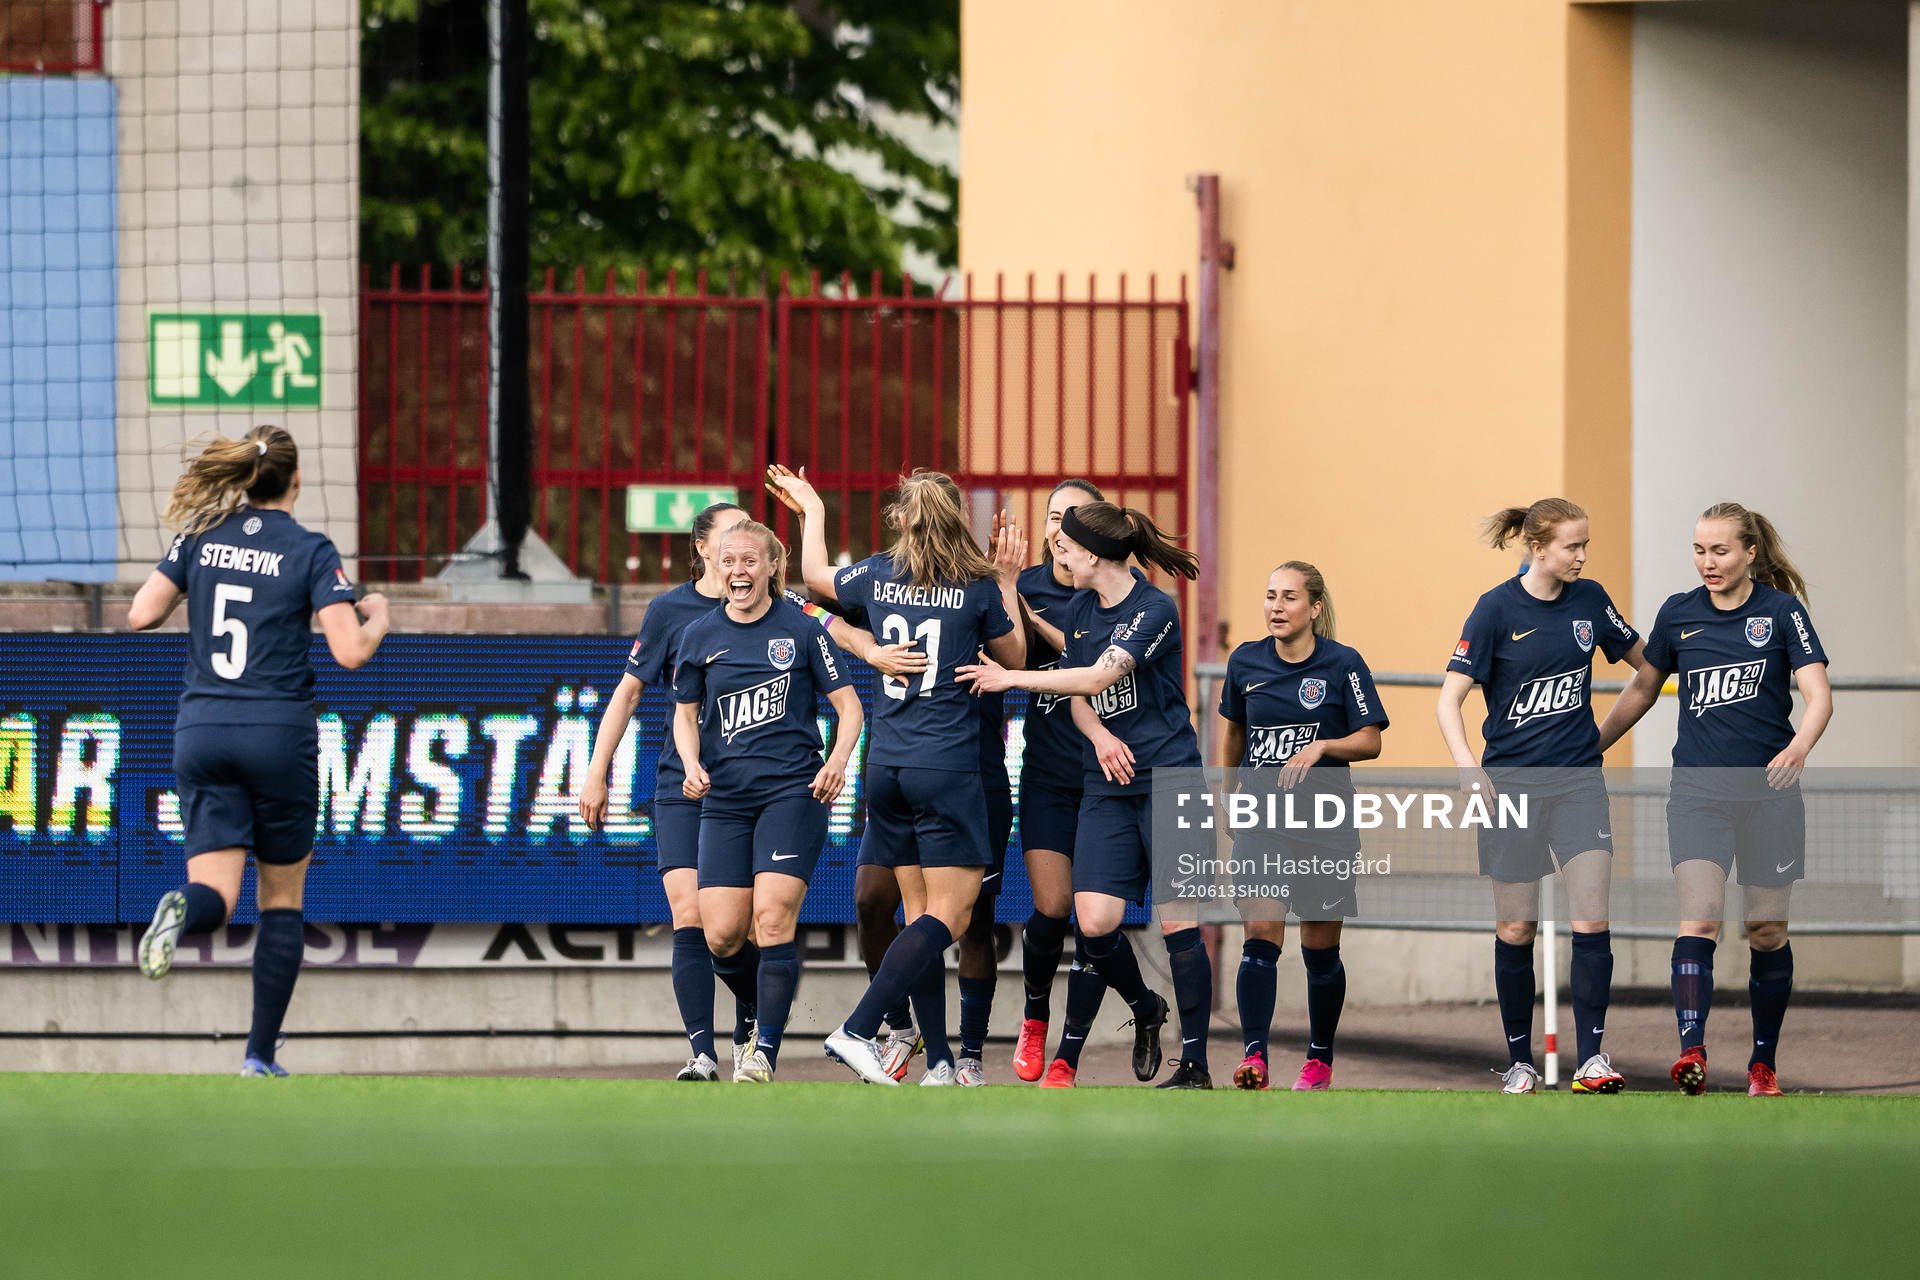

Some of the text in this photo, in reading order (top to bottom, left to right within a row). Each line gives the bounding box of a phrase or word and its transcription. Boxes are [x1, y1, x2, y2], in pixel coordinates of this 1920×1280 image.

[199, 542, 285, 577] STENEVIK
[873, 580, 965, 609] BÆKKELUND
[211, 583, 253, 680] 5
[1144, 620, 1173, 659] stadium
[1791, 611, 1813, 655] stadium
[816, 635, 839, 681] stadium
[882, 613, 942, 701] 21
[1742, 665, 1761, 679] 20
[770, 679, 786, 697] 20
[1117, 675, 1131, 690] 20
[1348, 671, 1369, 716] stadium
[1516, 675, 1573, 715] JAG
[1694, 667, 1741, 704] JAG
[1738, 683, 1754, 697] 30
[724, 687, 770, 731] JAG
[769, 700, 783, 717] 30
[1119, 697, 1132, 707] 30
[1253, 728, 1296, 760] JAG
[1297, 726, 1313, 739] 20
